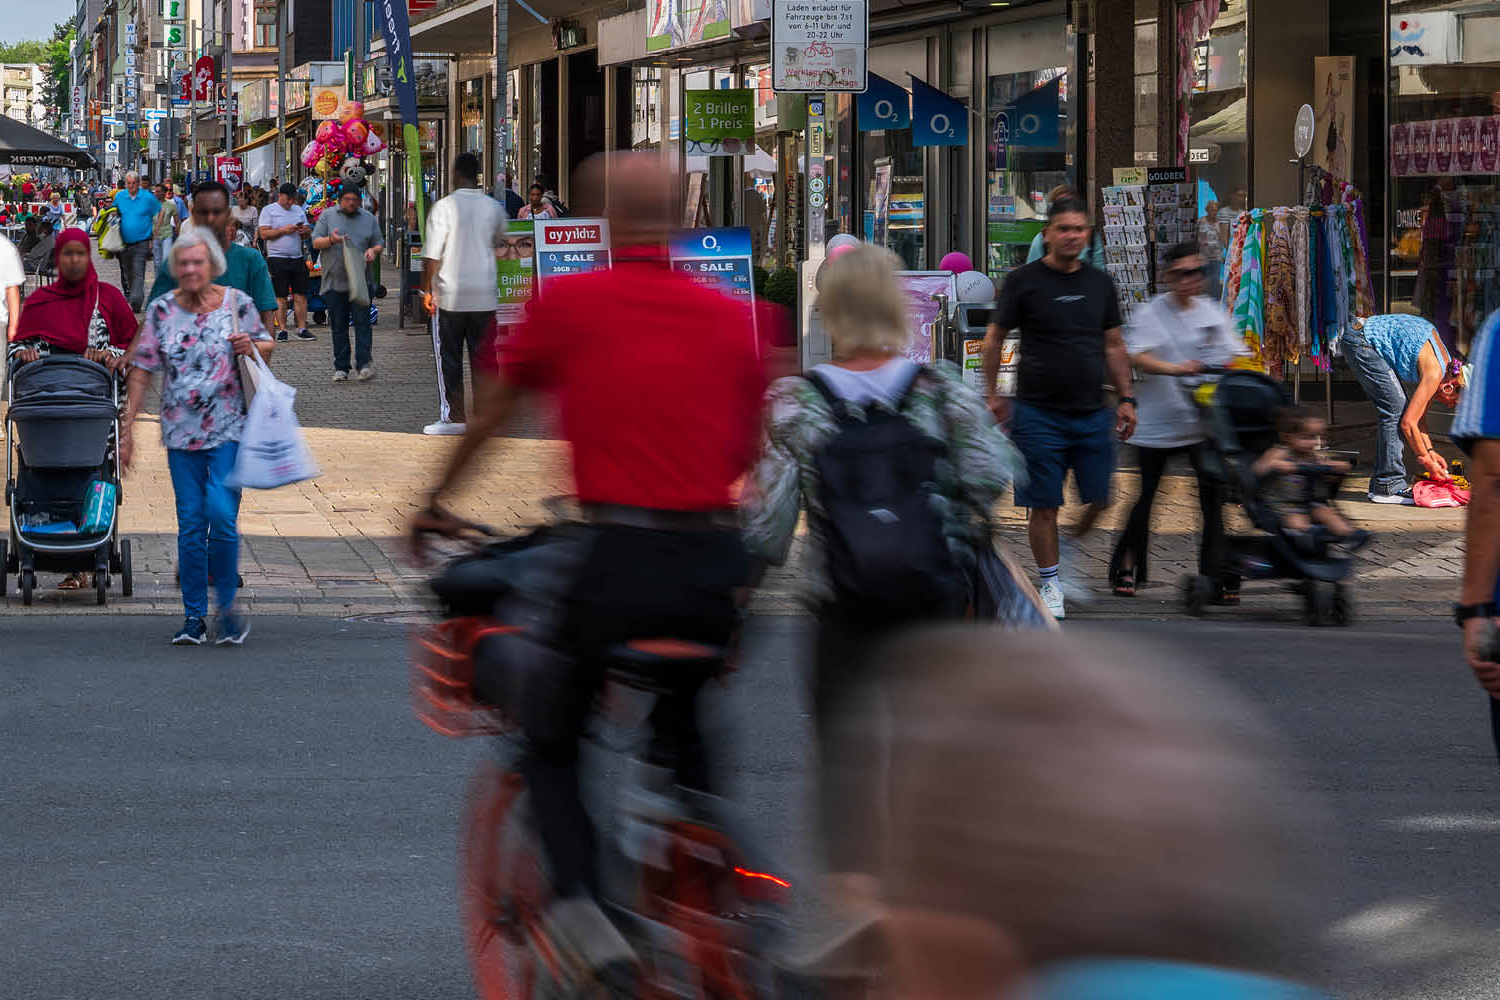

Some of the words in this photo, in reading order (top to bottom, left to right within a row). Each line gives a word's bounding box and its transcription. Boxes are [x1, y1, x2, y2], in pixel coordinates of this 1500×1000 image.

[785, 13, 824, 21] Fahrzeuge
[806, 31, 828, 39] 20-22
[831, 31, 844, 39] Uhr
[693, 103, 702, 114] 2
[705, 102, 748, 115] Brillen
[699, 118, 707, 129] 1
[710, 118, 743, 129] Preis
[563, 254, 595, 262] SALE
[700, 263, 734, 272] SALE
